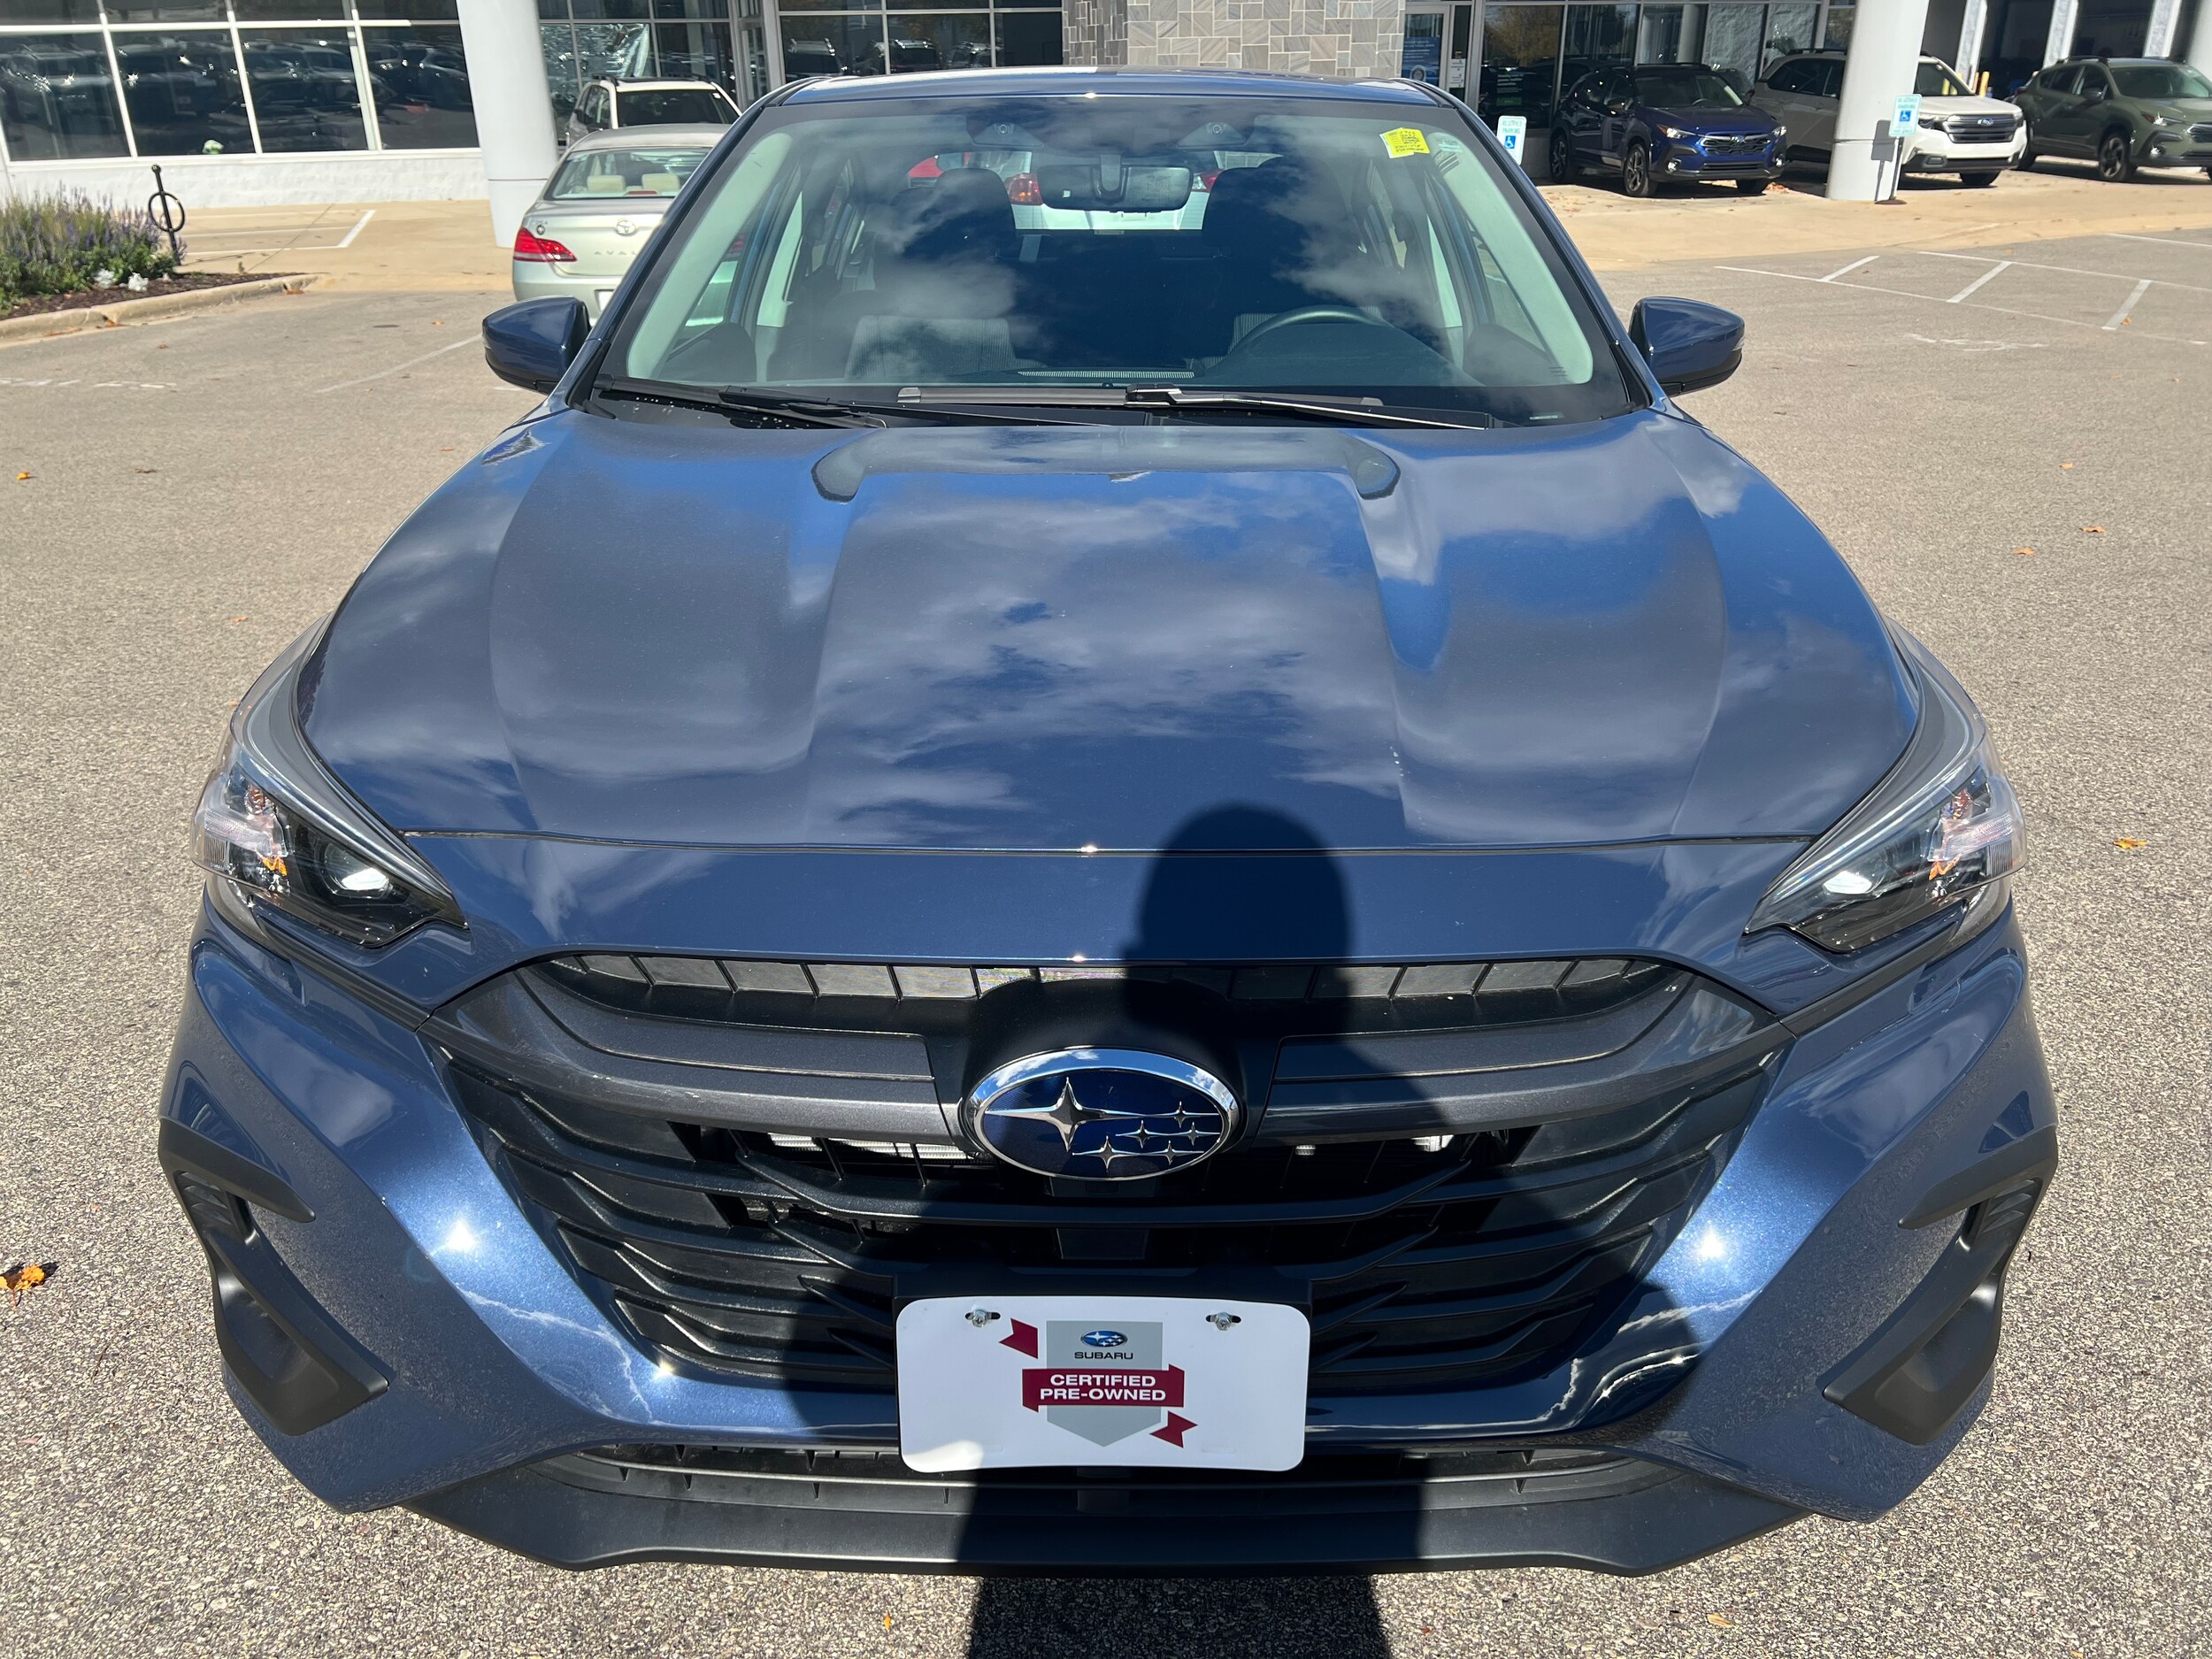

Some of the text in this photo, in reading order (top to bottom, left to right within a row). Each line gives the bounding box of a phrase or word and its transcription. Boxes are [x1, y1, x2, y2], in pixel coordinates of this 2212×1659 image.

[1074, 1351, 1133, 1360] SUBARU
[1050, 1374, 1156, 1386] CERTIFIED
[1040, 1388, 1166, 1401] PRE-OWNED
